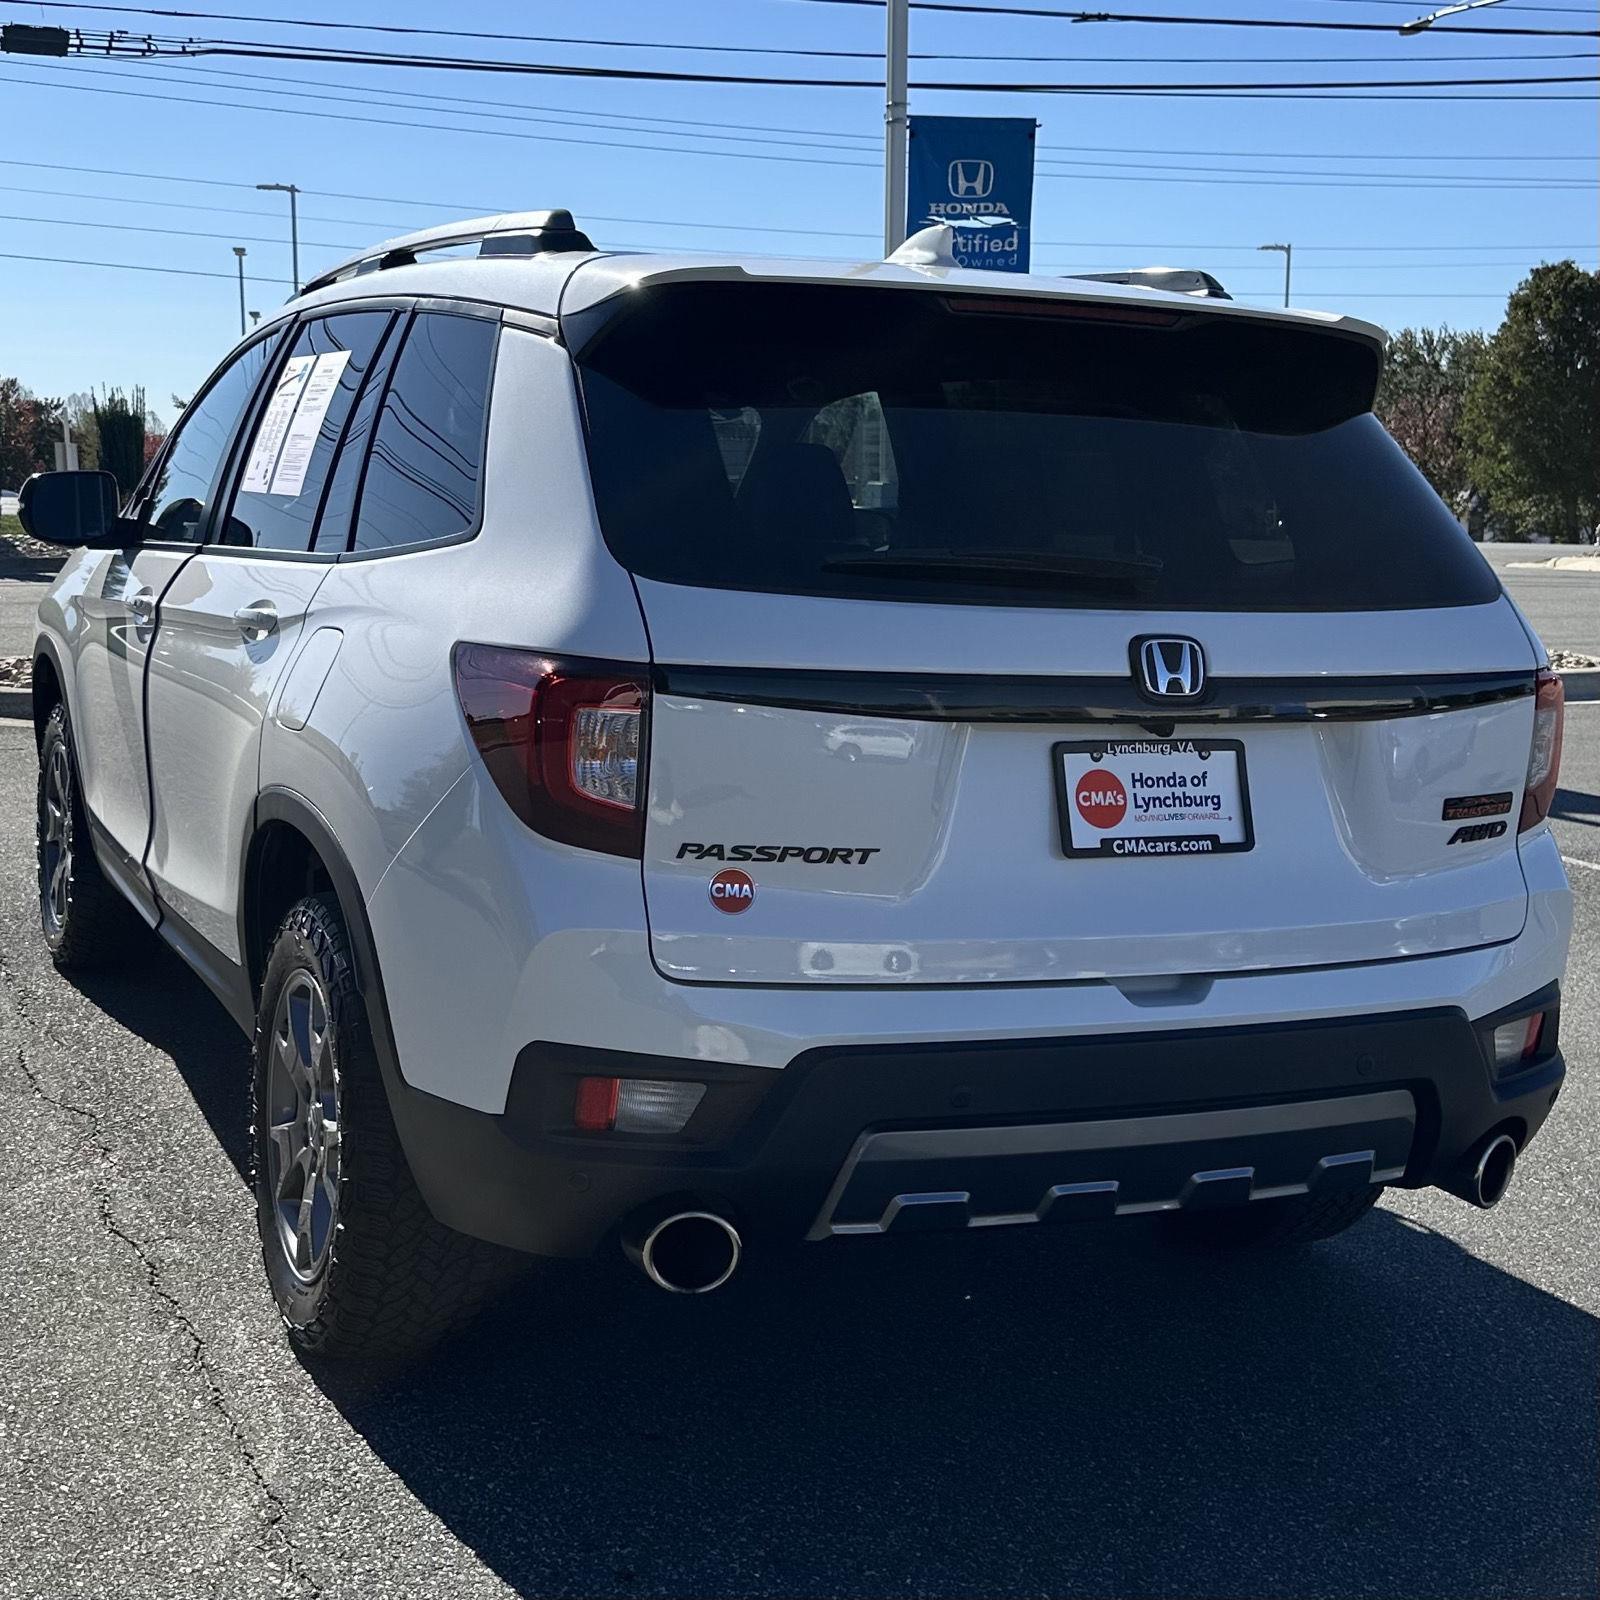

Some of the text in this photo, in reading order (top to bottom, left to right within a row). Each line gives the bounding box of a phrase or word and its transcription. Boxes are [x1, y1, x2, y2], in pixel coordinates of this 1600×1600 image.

[928, 202, 1010, 214] HONDA
[1177, 741, 1195, 753] VA
[1131, 771, 1208, 788] Honda of
[1078, 791, 1125, 807] CMA's
[1133, 792, 1221, 813] Lynchburg
[675, 843, 880, 865] PASSPORT
[1112, 839, 1213, 854] CMAcars.com
[711, 883, 752, 898] CMA
